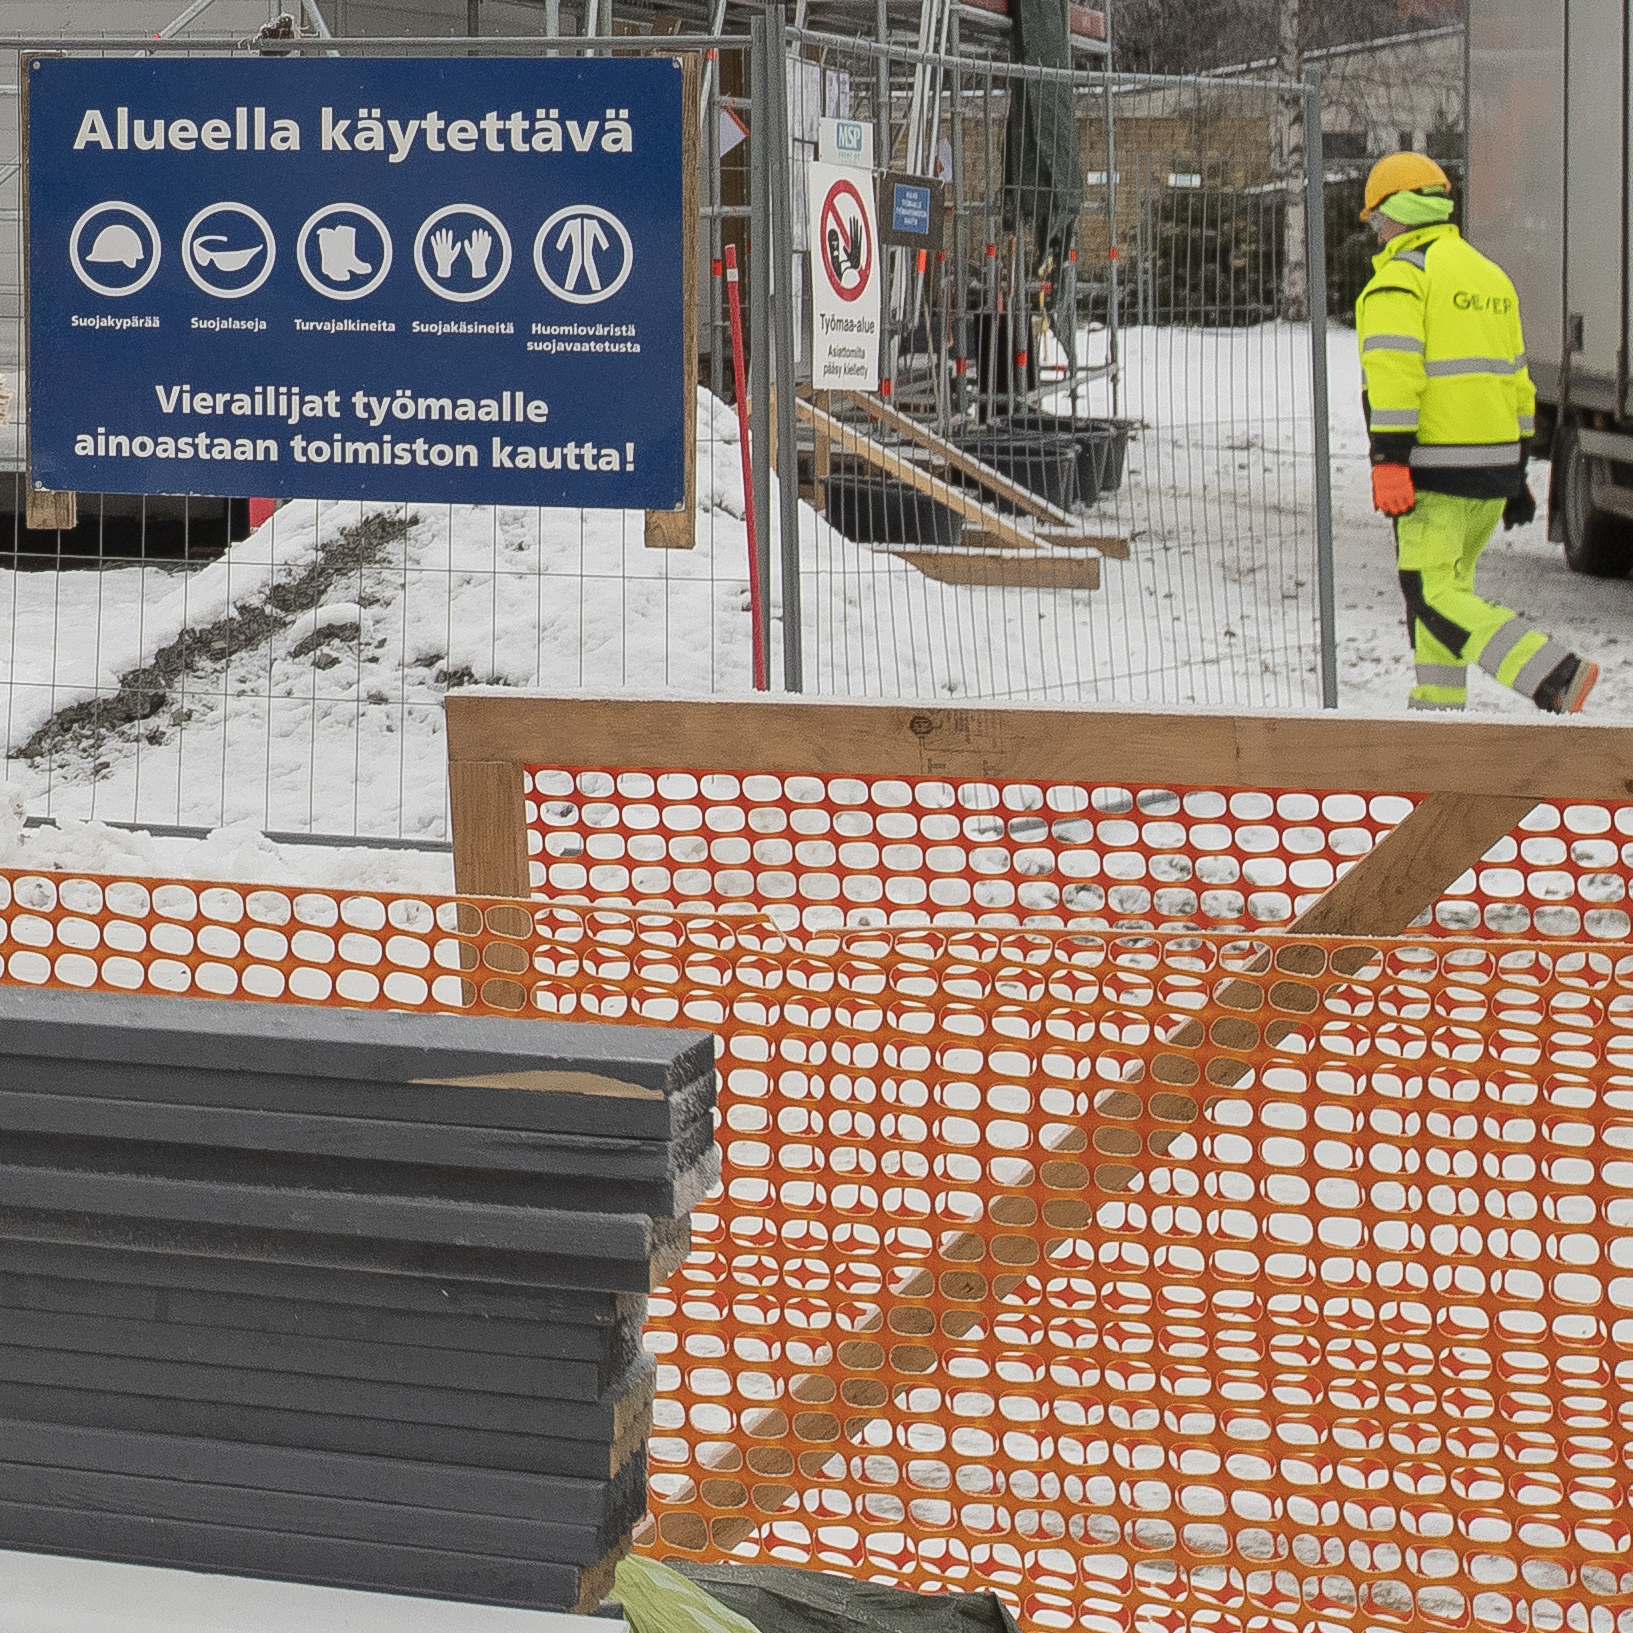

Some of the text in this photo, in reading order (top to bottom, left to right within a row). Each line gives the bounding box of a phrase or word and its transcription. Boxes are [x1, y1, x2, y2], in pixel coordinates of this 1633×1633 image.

[74, 107, 633, 163] Alueella käytettävä
[838, 124, 861, 149] MSP
[71, 315, 160, 329] Suojakypärää
[190, 317, 267, 332] Suojalaseja
[294, 319, 396, 333] Turvajalkineita
[412, 320, 514, 335] Suojakäsineitä
[531, 323, 636, 336] Huomioväristä
[819, 313, 875, 336] Työmaa-alue
[527, 340, 640, 354] suojavaatetusta
[155, 385, 549, 426] Vierailijat työmaalle
[74, 427, 635, 472] ainoastaan toimiston kautta!
